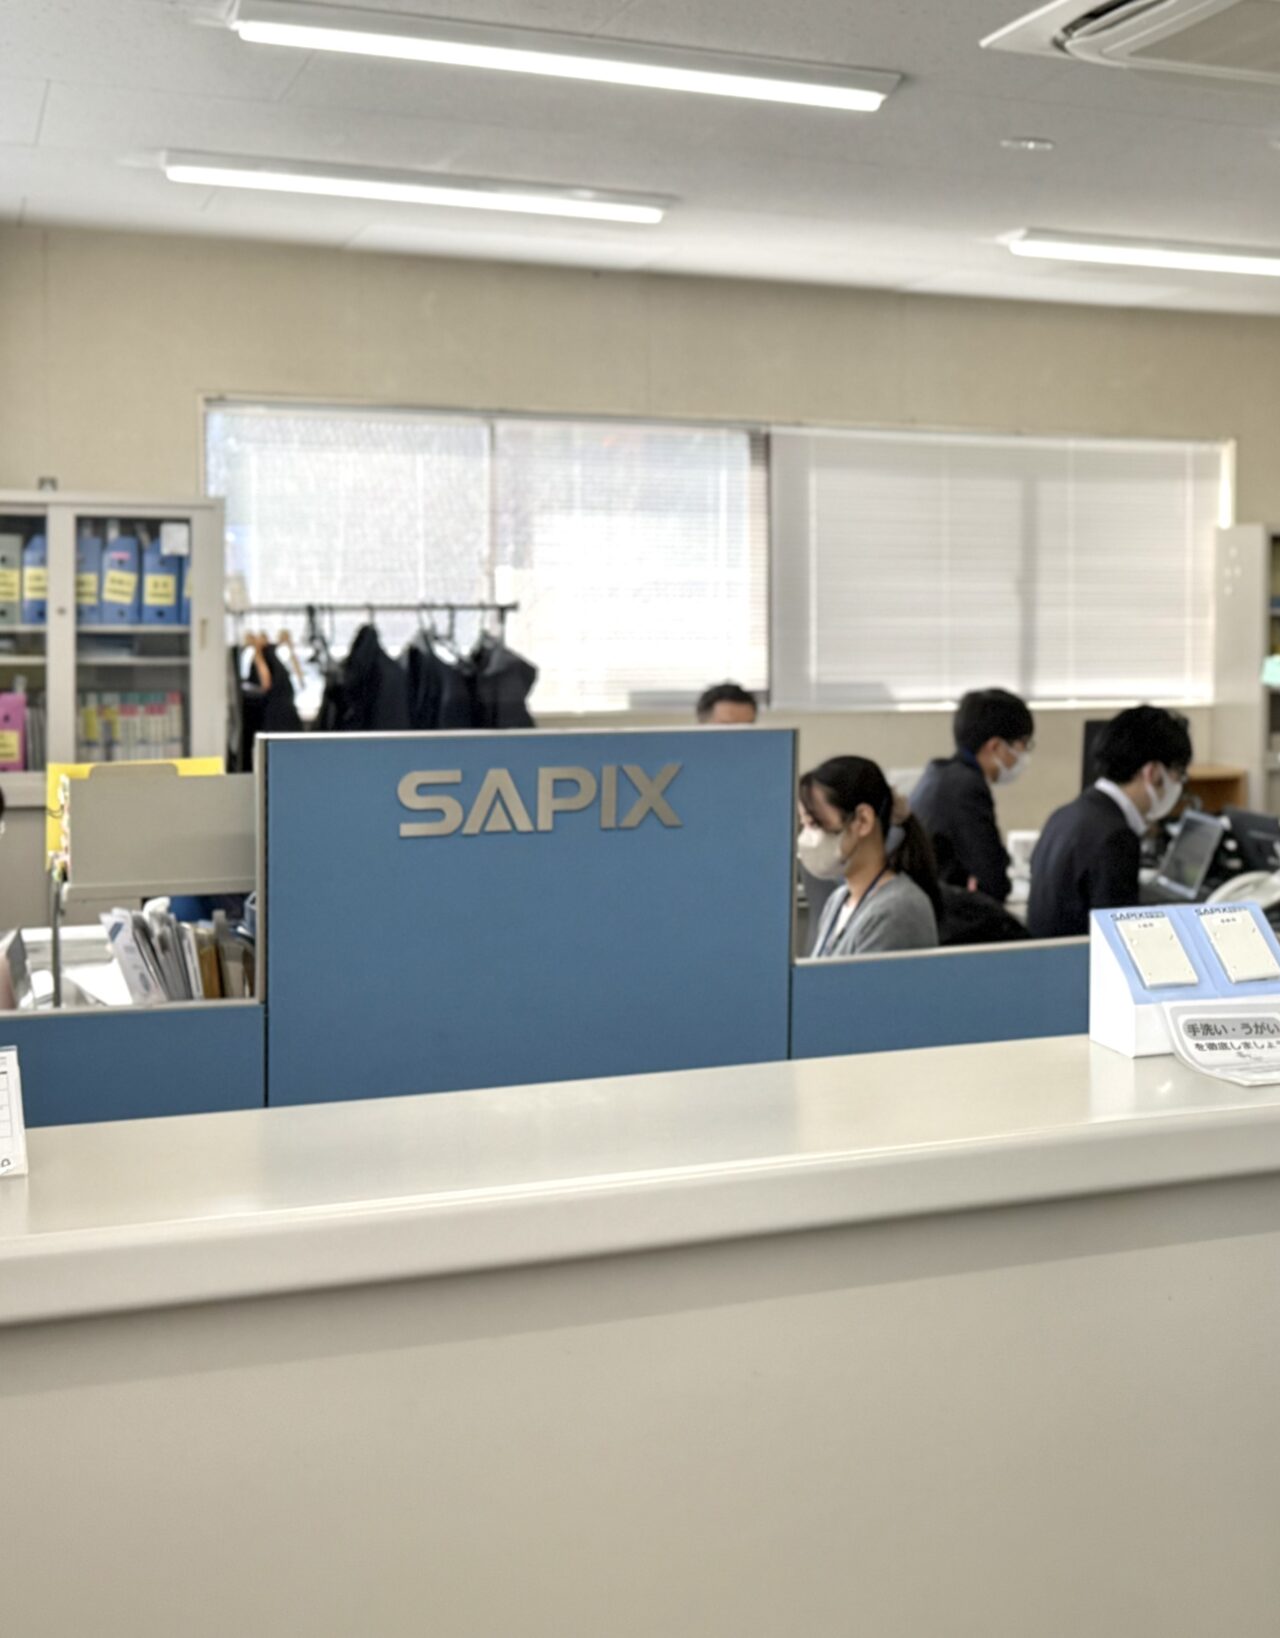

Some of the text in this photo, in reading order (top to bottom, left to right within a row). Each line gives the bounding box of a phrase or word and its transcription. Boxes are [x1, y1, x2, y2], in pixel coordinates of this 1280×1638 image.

[396, 762, 684, 838] SAPIX
[1186, 1022, 1280, 1037] 手洗い・うがい
